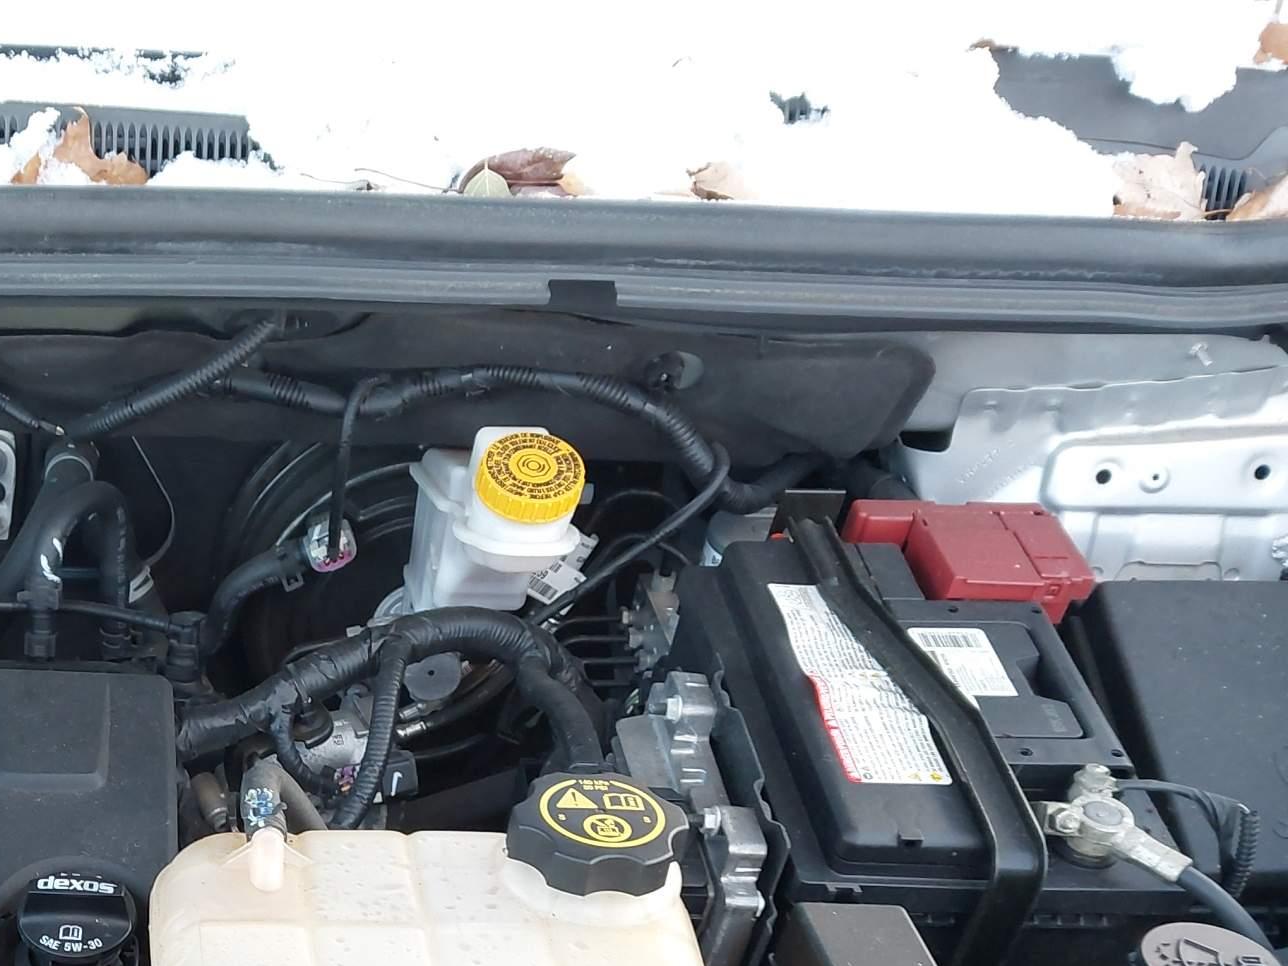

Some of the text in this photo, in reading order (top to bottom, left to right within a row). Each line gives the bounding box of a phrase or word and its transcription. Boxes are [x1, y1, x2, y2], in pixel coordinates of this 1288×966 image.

[37, 876, 118, 894] dexos
[39, 935, 103, 952] SAE 5W-30
